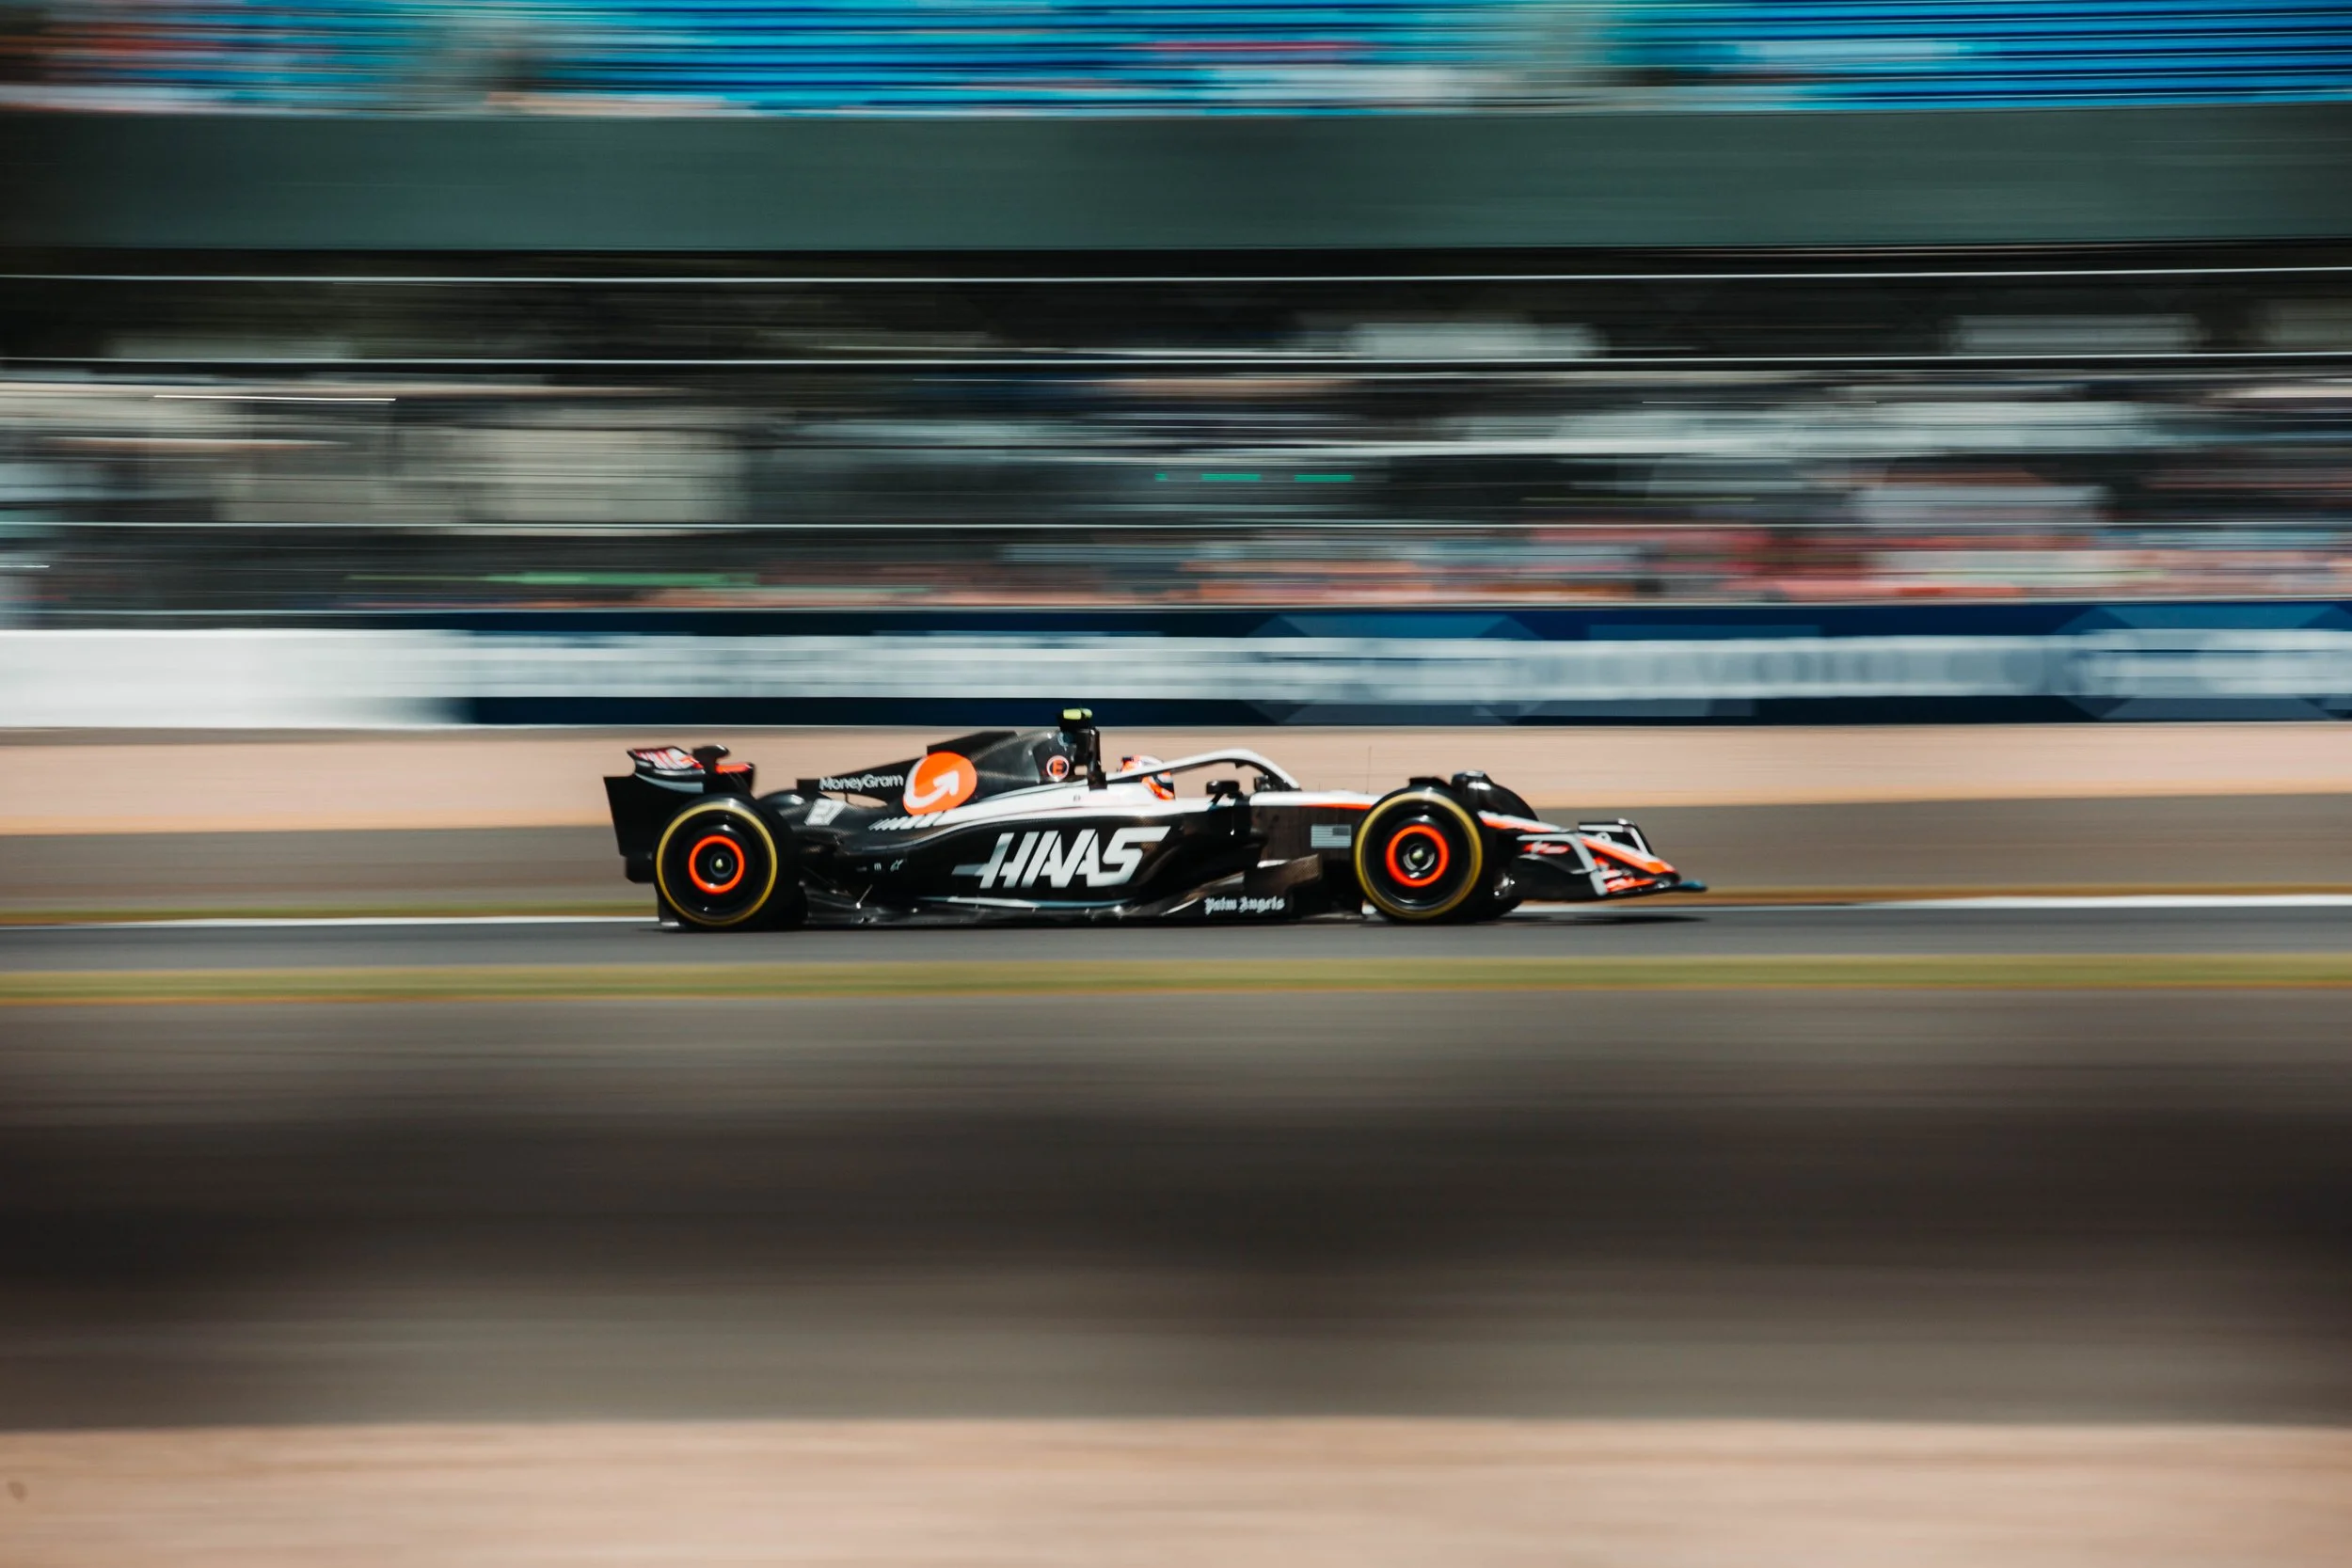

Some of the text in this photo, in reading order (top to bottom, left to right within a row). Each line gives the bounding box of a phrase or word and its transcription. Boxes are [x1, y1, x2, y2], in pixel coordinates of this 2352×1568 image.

[1052, 758, 1065, 776] E
[819, 774, 904, 791] MoneyGram
[951, 826, 1171, 889] HAAS
[1204, 895, 1285, 916] Palm Angels
